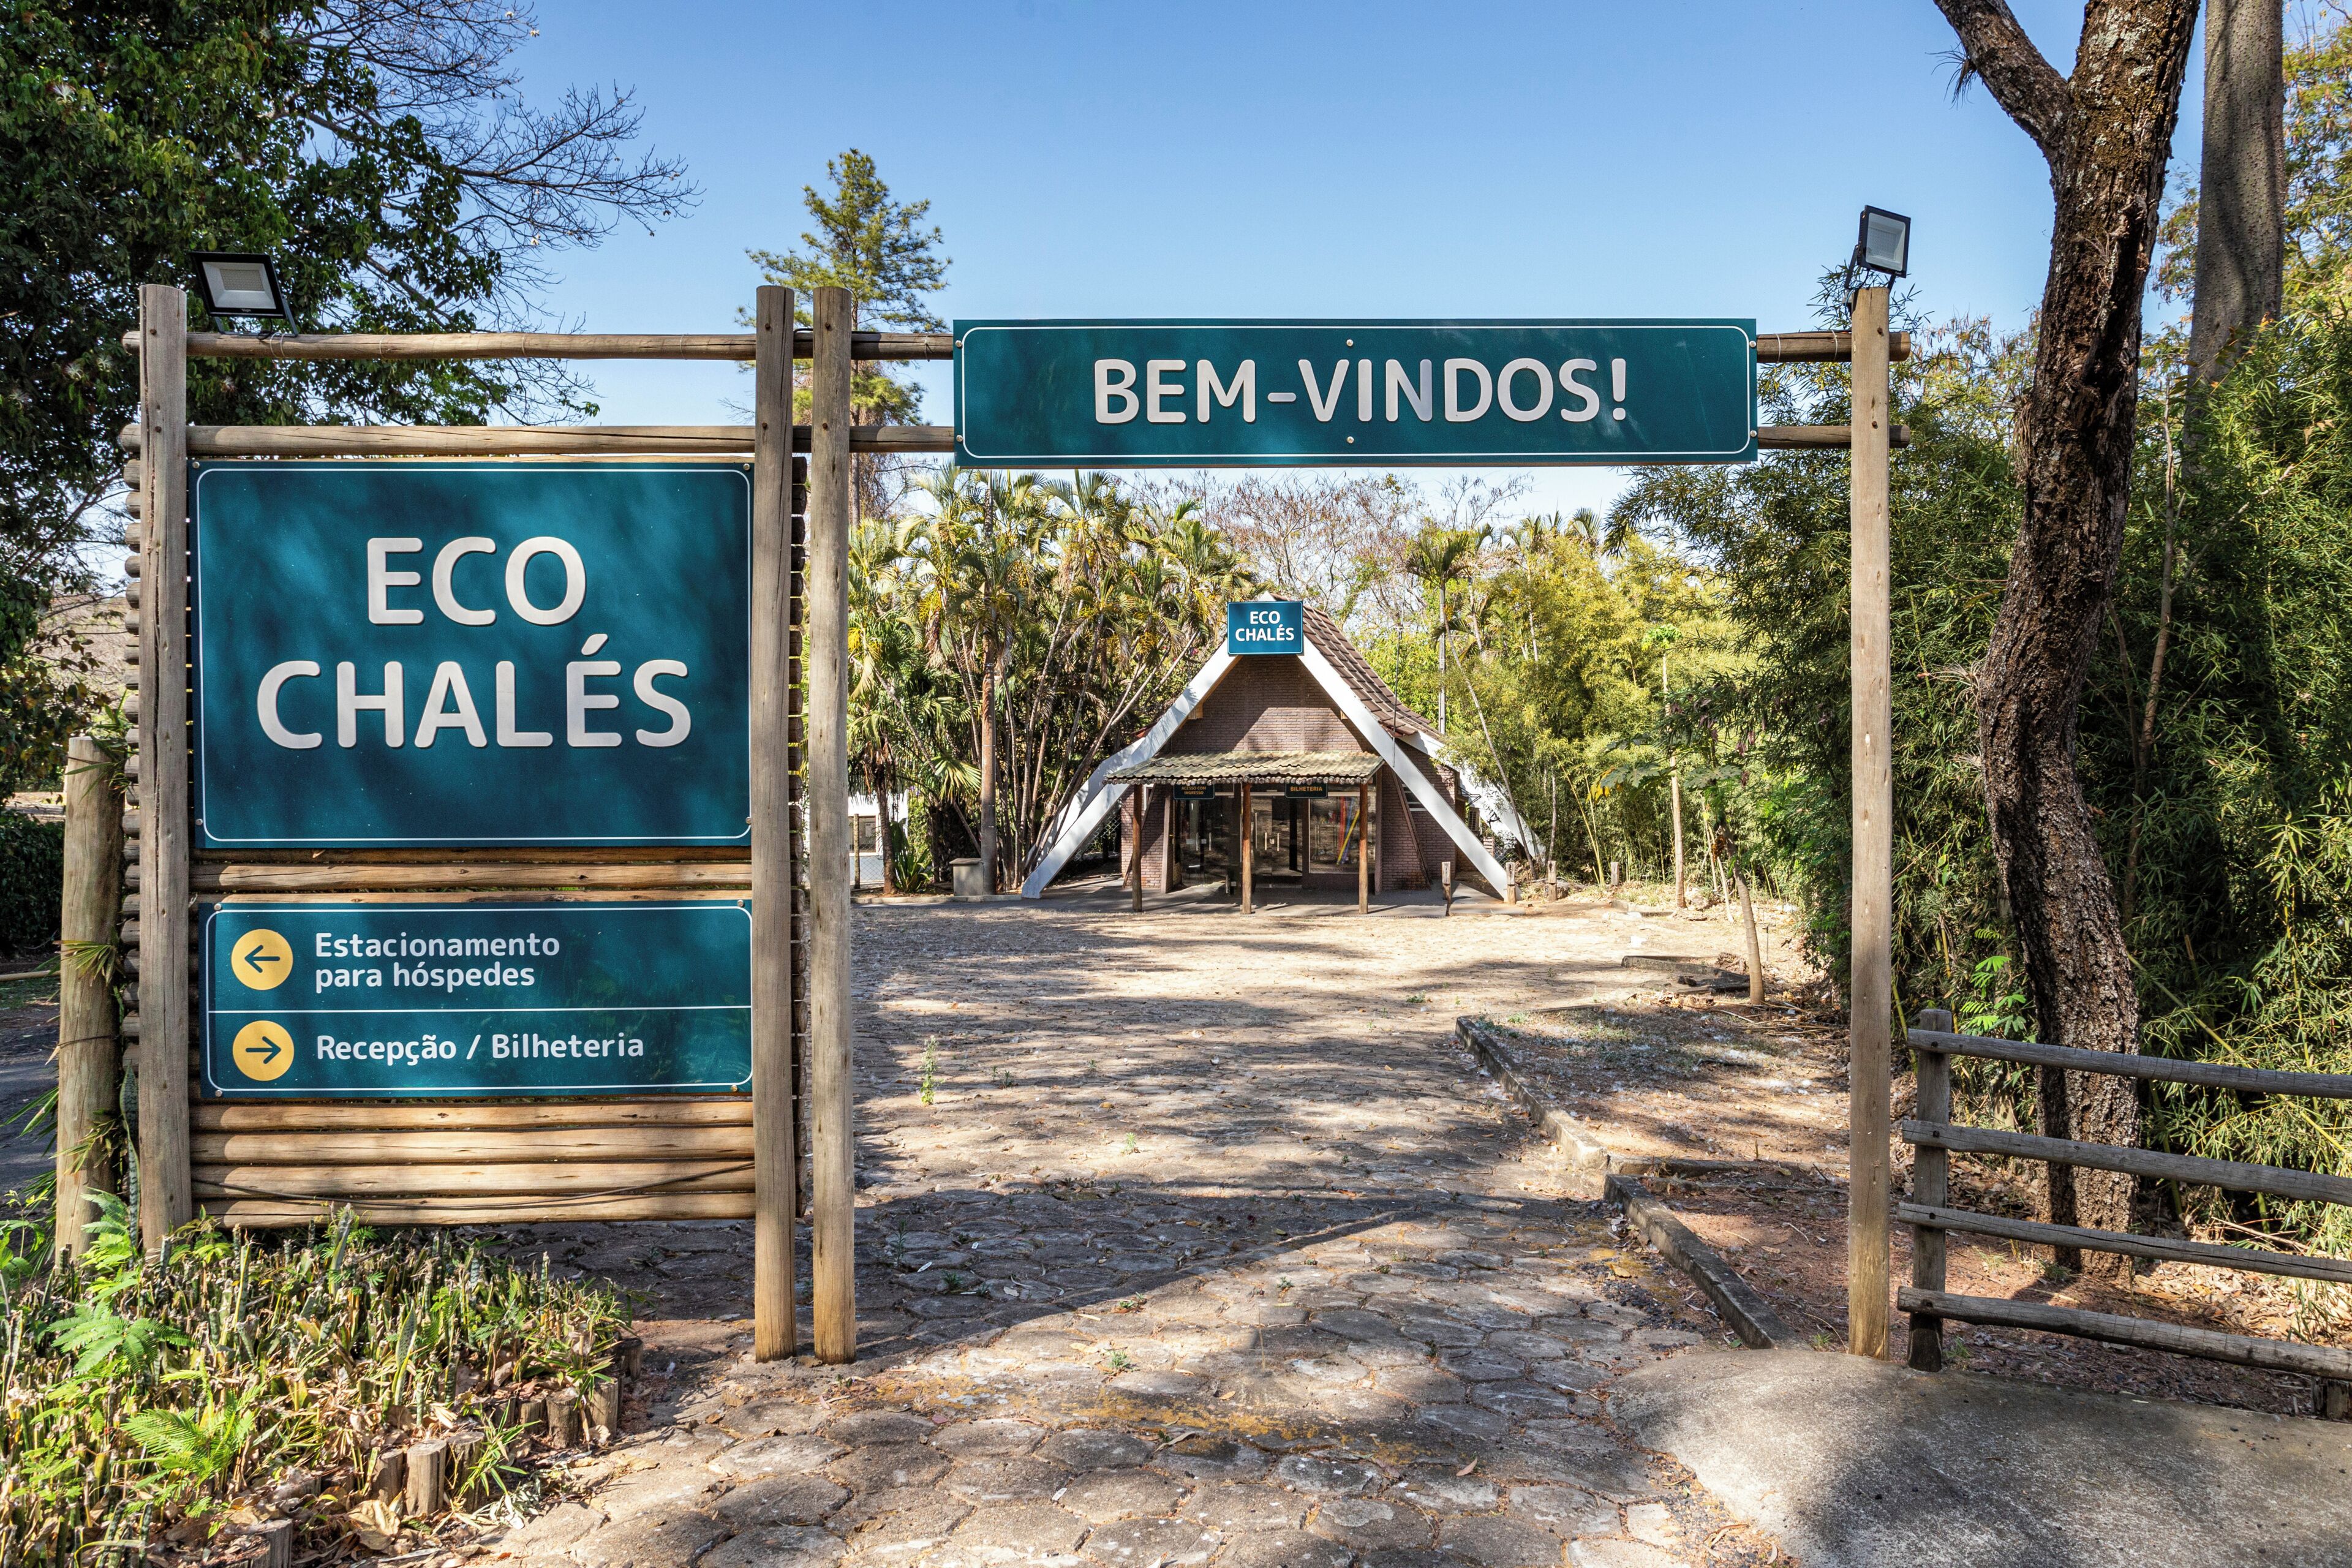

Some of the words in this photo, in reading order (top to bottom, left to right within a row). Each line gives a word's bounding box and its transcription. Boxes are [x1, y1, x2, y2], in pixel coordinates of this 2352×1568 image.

[1093, 358, 1627, 424] BEM-VINDOS!
[366, 536, 587, 626] ECO
[1235, 624, 1295, 642] CHALÉS
[1250, 611, 1281, 624] ECO
[256, 633, 692, 750] CHALÉS
[315, 932, 560, 958] Estacionamento
[315, 968, 383, 995] para
[393, 960, 535, 993] hóspedes
[317, 1033, 458, 1067] Recepção
[491, 1032, 644, 1060] Bilheteria
